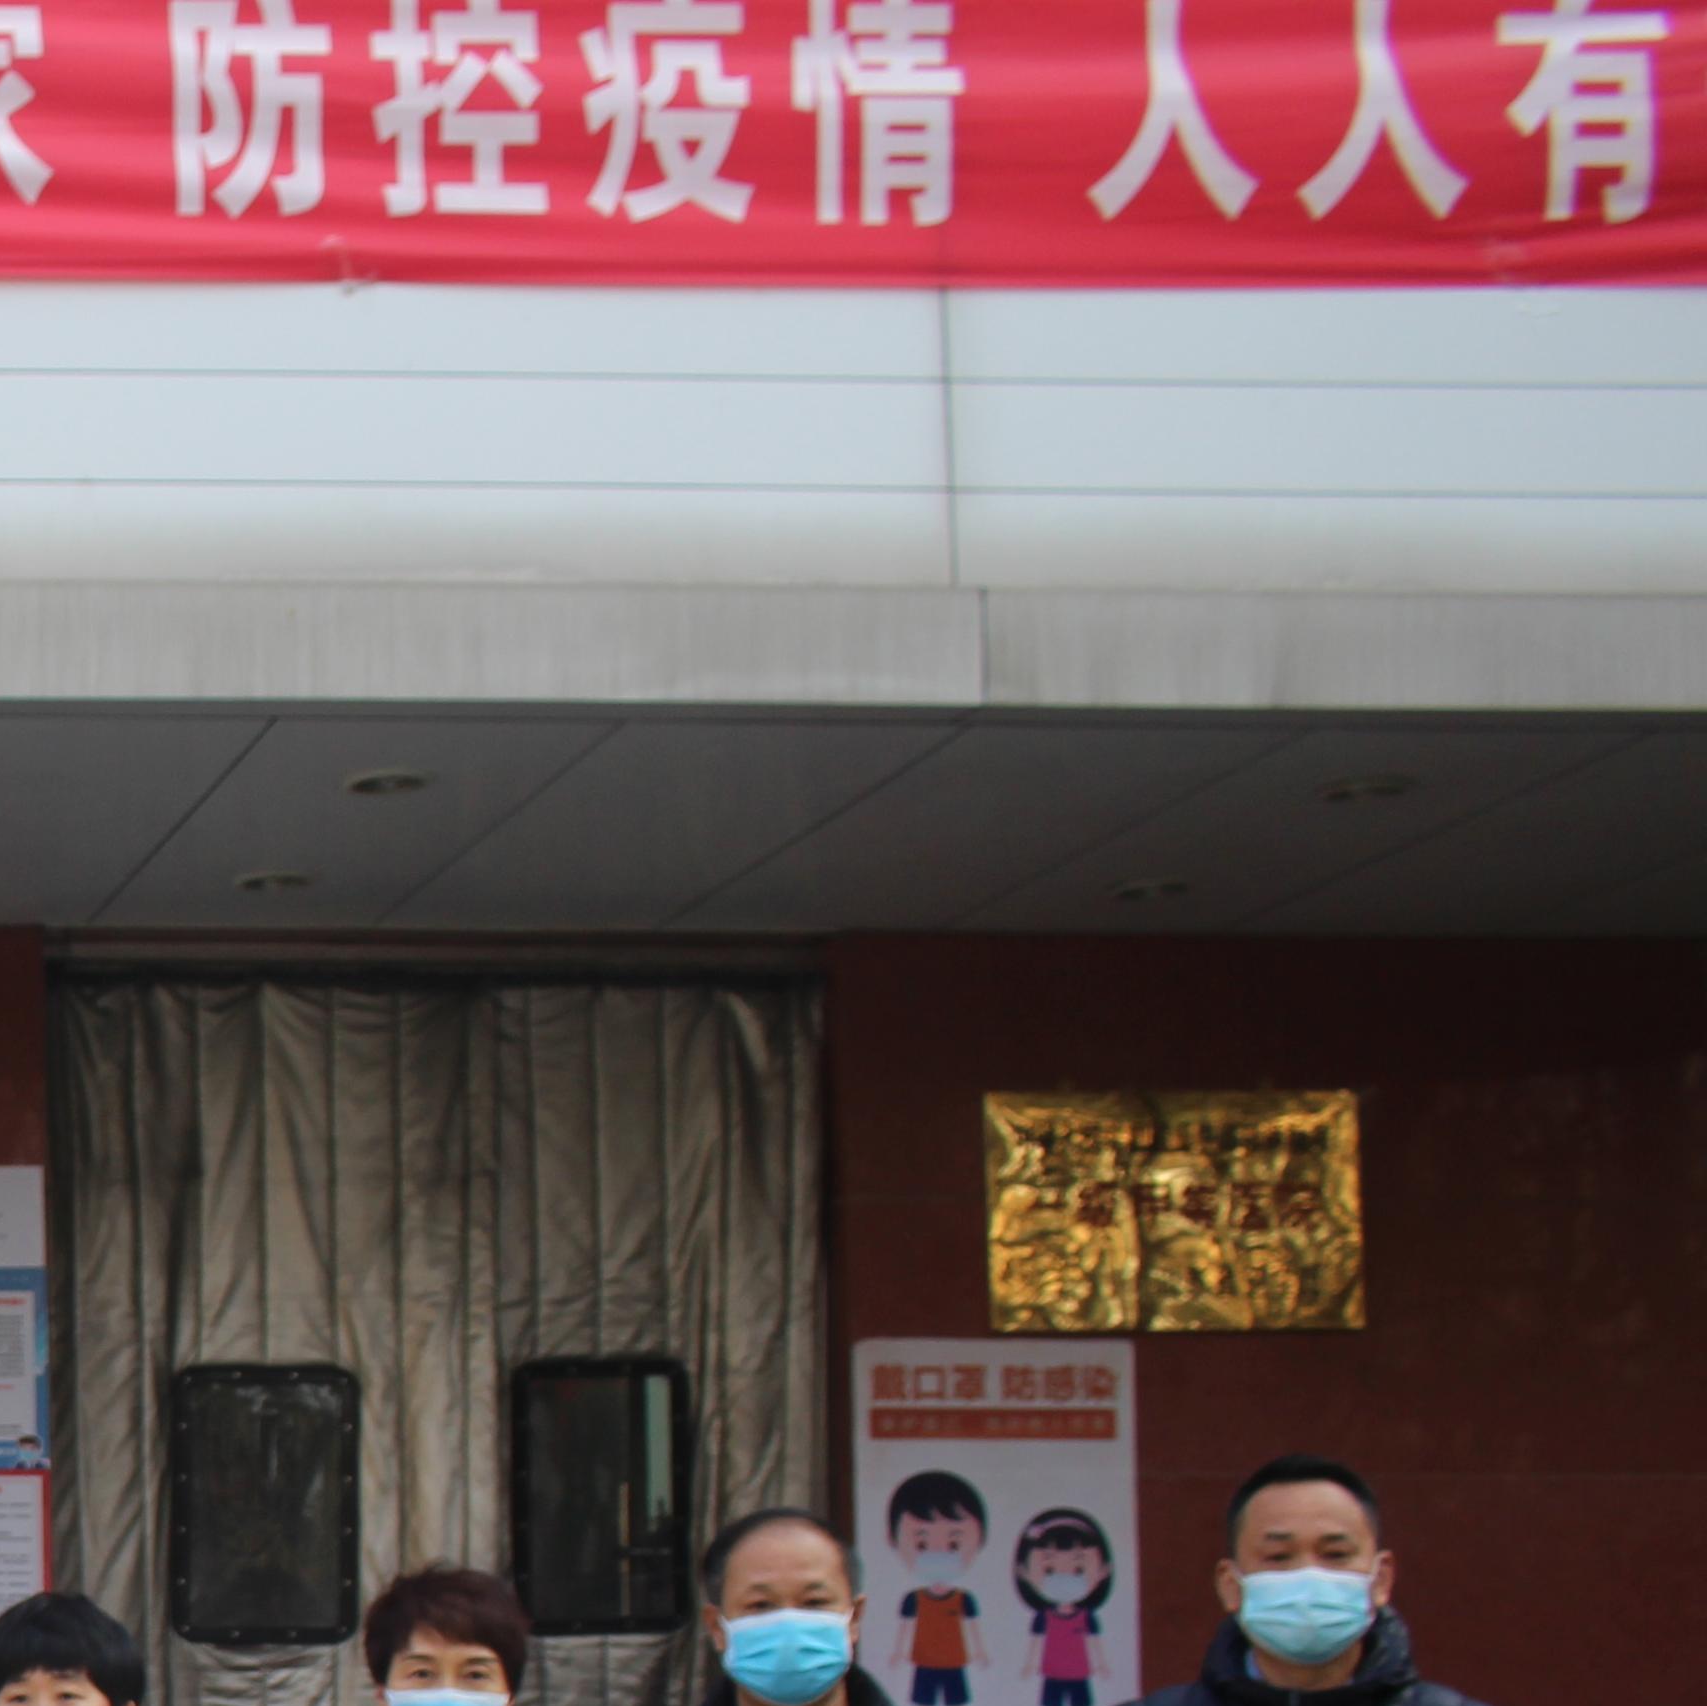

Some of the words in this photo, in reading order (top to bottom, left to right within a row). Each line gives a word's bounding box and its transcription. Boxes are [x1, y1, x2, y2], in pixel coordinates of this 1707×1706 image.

[169, 0, 968, 226] 防控疫情
[1088, 0, 1671, 224] 人人有
